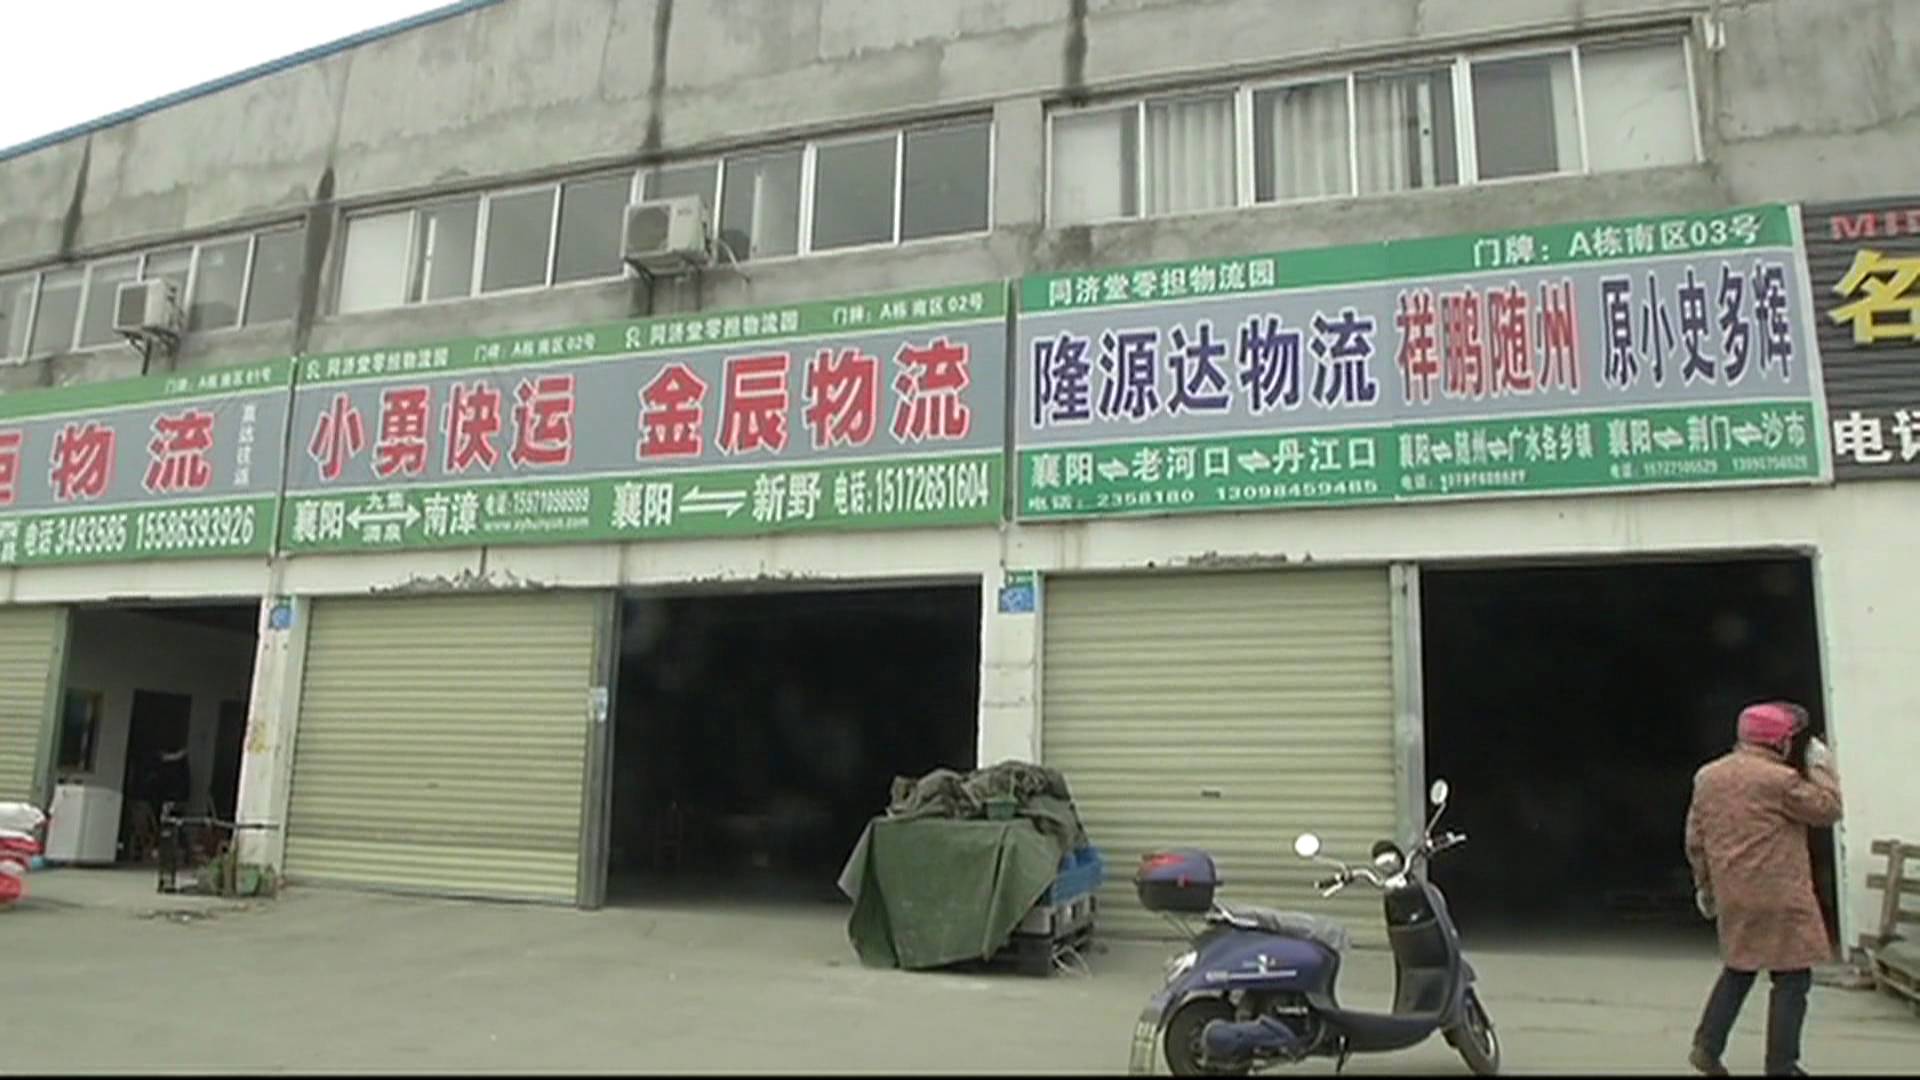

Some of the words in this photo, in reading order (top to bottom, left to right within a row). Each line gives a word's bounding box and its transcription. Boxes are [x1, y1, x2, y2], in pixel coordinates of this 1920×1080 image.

[1048, 258, 1276, 307] 同济堂零担物流园
[1828, 250, 1920, 344] 名
[649, 309, 799, 345] 同济堂零担物流园
[1031, 307, 1377, 428] 隆源达物流
[1395, 278, 1579, 402] 祥鹏随州
[306, 372, 577, 482] 小勇快运
[636, 335, 972, 461] 金辰物流
[1031, 452, 1094, 489] 襄阳
[1131, 446, 1231, 482] 老河口
[1272, 436, 1376, 475] 丹江口
[292, 499, 345, 543] 襄阳
[423, 490, 480, 537] 南漳
[610, 482, 674, 530] 襄阳
[751, 471, 821, 524] 新野
